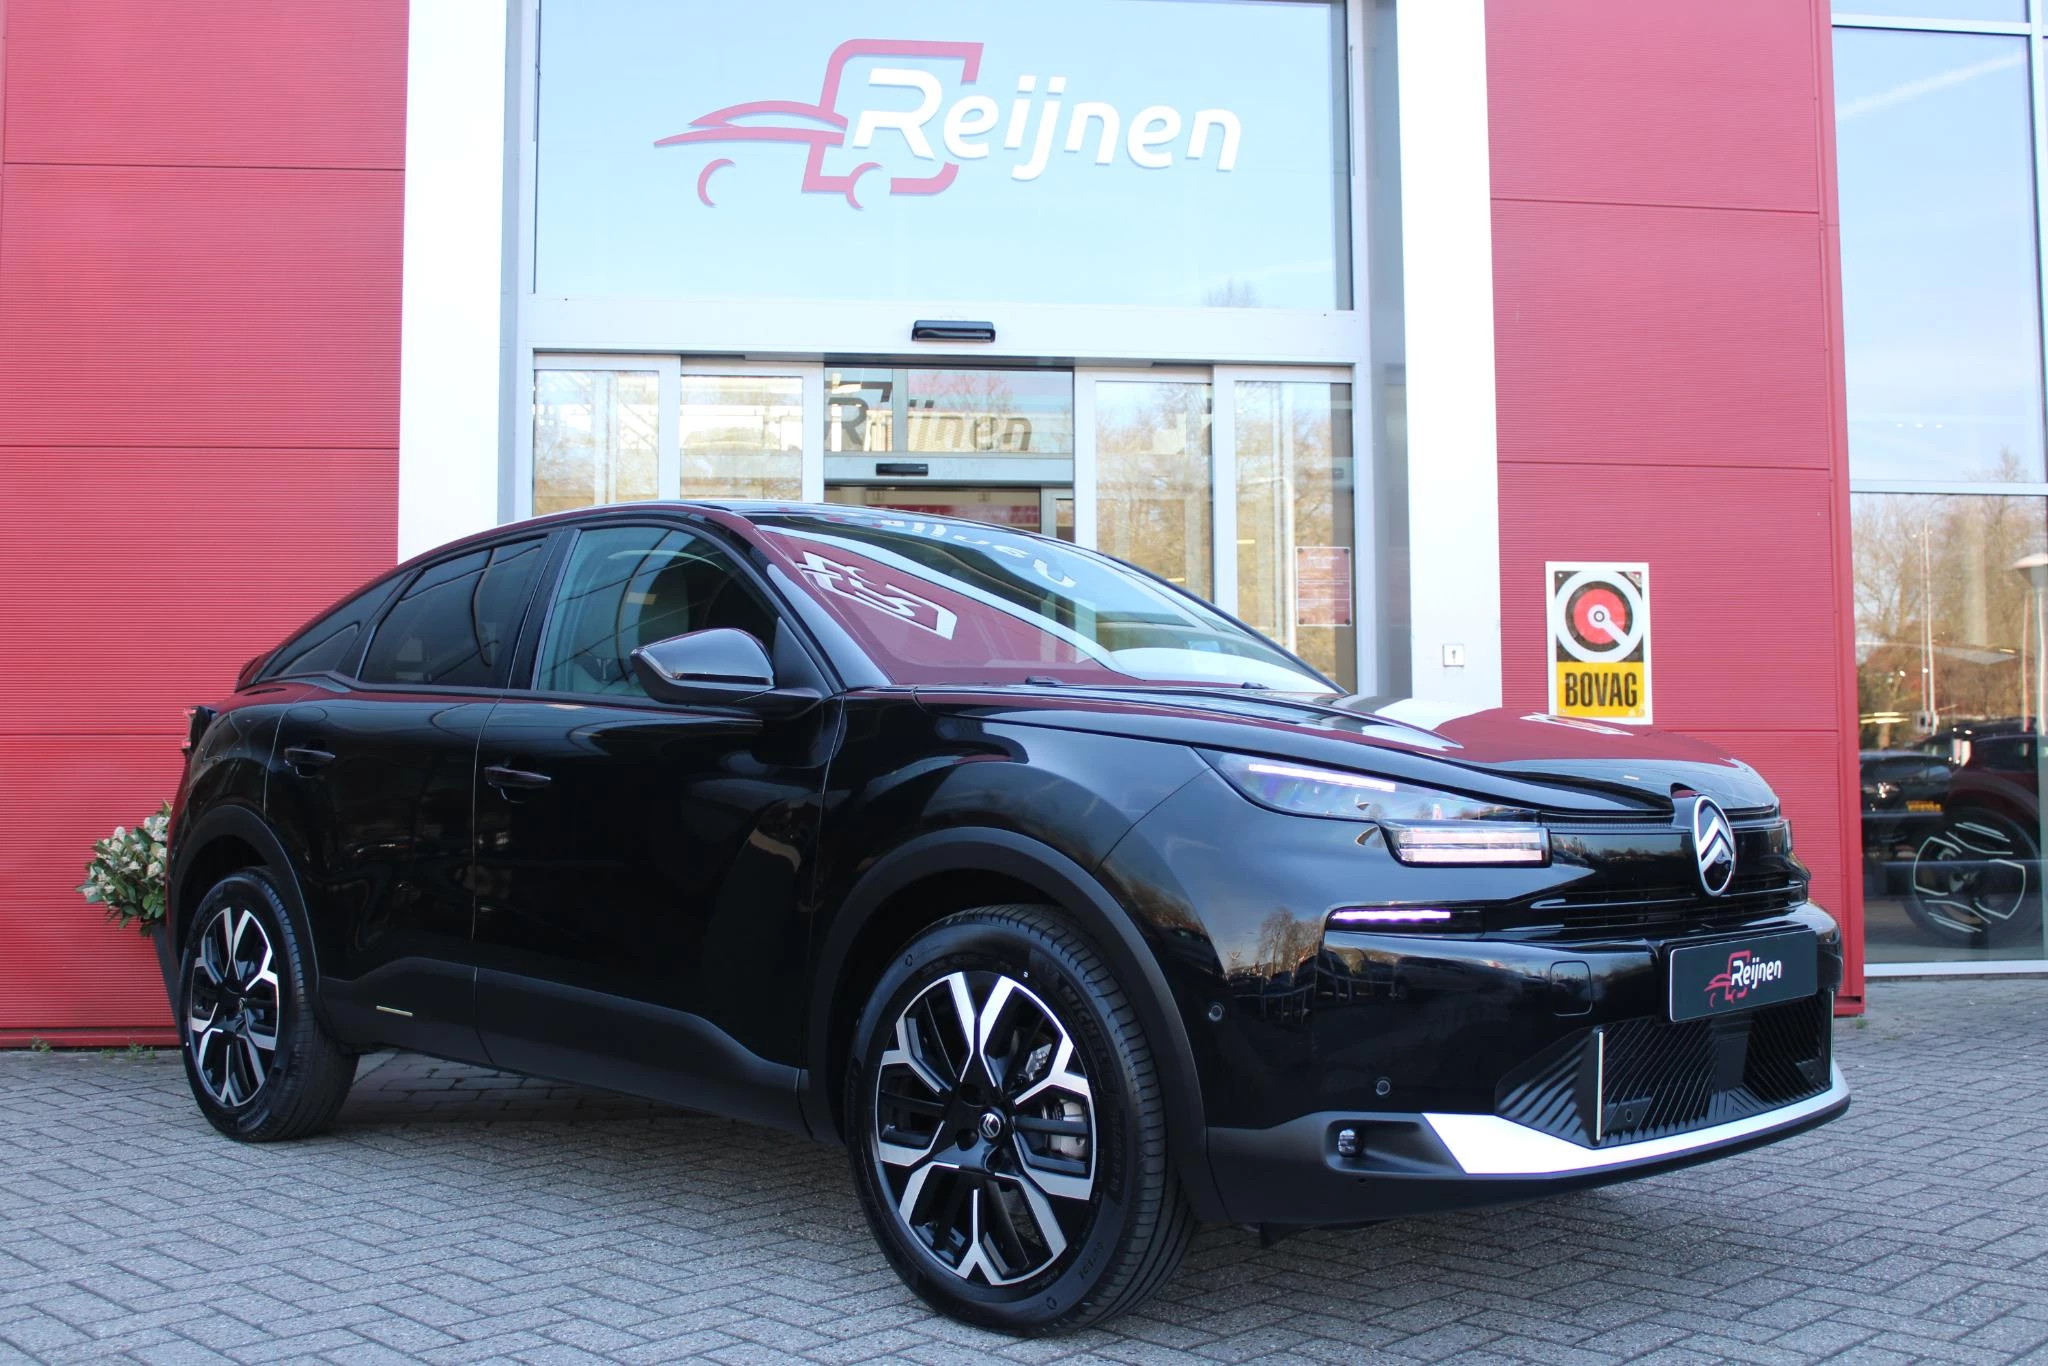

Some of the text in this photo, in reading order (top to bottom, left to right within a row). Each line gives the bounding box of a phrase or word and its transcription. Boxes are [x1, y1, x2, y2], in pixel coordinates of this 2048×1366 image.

[852, 68, 1242, 181] Reijnen
[825, 397, 1032, 452] Rijnen
[1565, 672, 1638, 708] BOVAG
[1731, 957, 1782, 989] Reijnen
